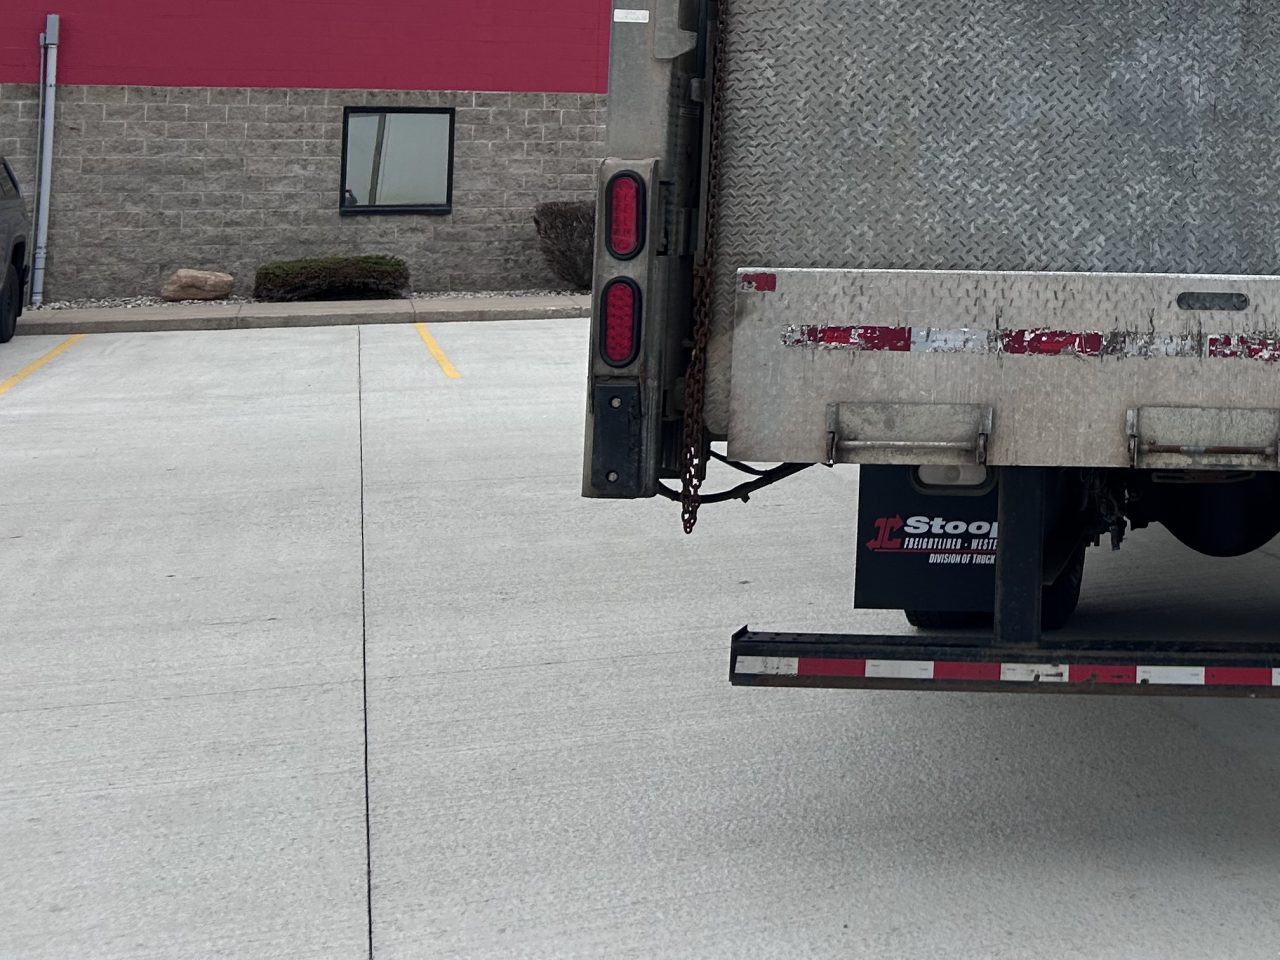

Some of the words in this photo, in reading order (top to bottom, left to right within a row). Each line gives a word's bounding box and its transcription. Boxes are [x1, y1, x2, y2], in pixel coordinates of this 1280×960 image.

[904, 538, 961, 549] FREIGHTLINER
[928, 553, 961, 564] DIVISION
[961, 554, 971, 564] OF
[972, 554, 996, 564] TRUCK
